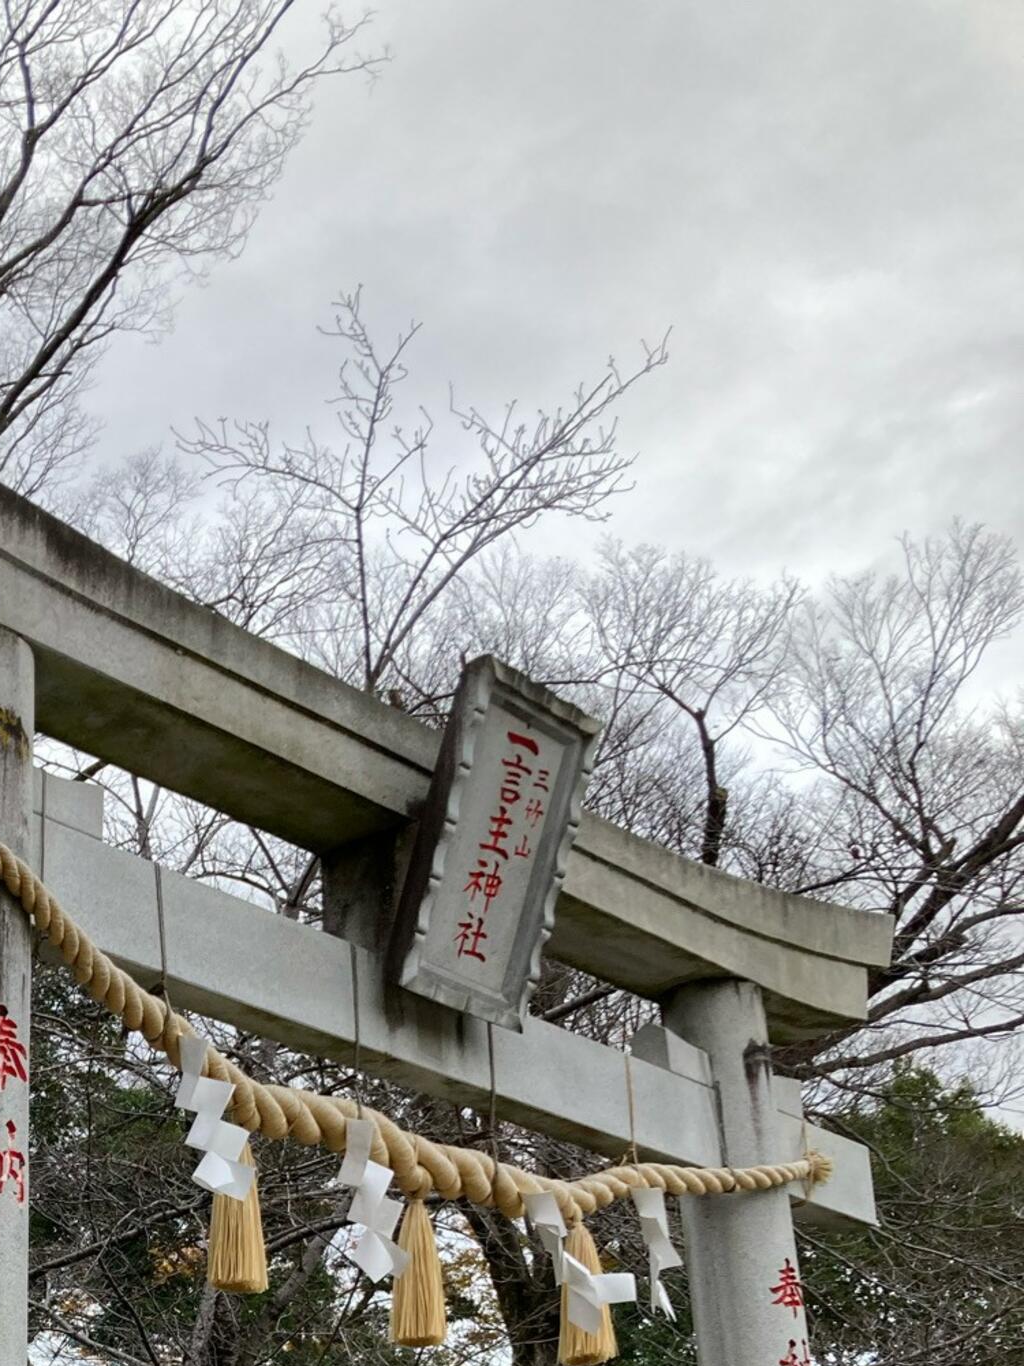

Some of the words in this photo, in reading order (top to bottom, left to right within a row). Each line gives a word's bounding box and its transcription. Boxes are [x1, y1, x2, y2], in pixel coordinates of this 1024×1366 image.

[452, 730, 541, 963] 一言主神社
